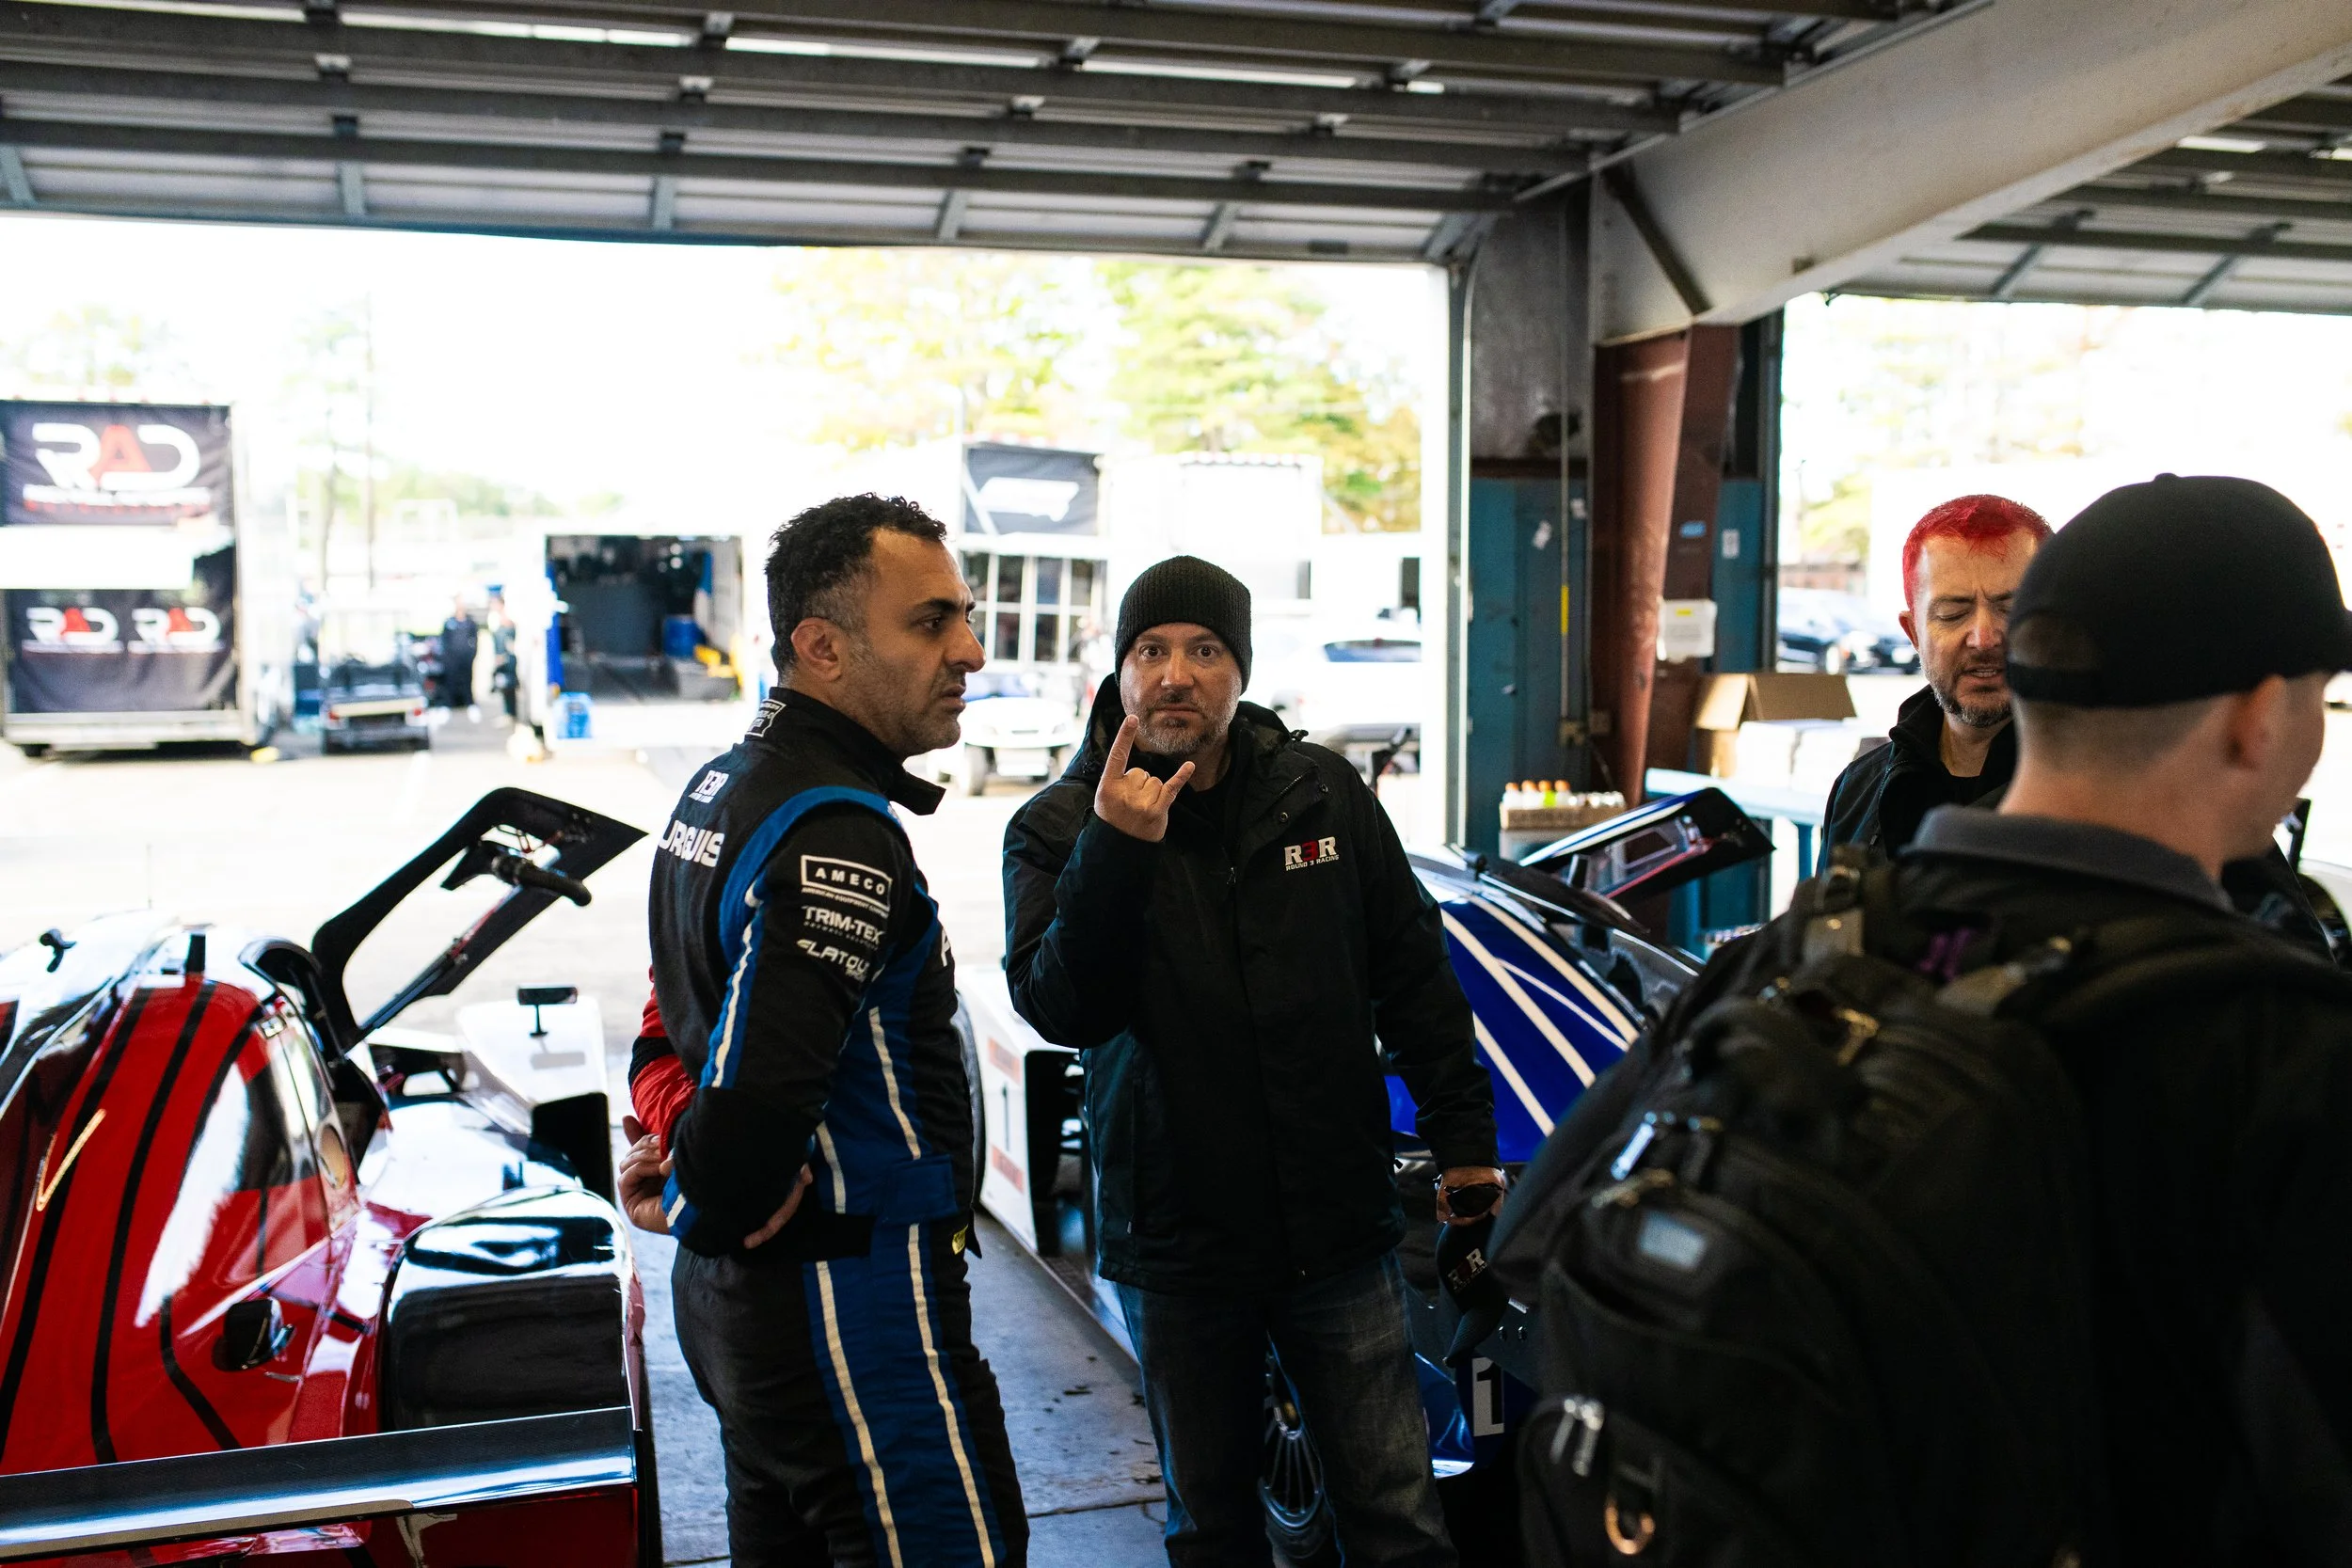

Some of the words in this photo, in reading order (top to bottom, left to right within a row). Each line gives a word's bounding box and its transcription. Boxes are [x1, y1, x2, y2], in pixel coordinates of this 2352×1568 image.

[32, 422, 200, 490] RAD
[26, 607, 119, 644] RAD
[132, 607, 222, 644] RAD
[1284, 836, 1337, 865] R3R
[1285, 862, 1308, 871] ROUND
[1316, 854, 1340, 864] RACING
[815, 867, 886, 895] AMECO
